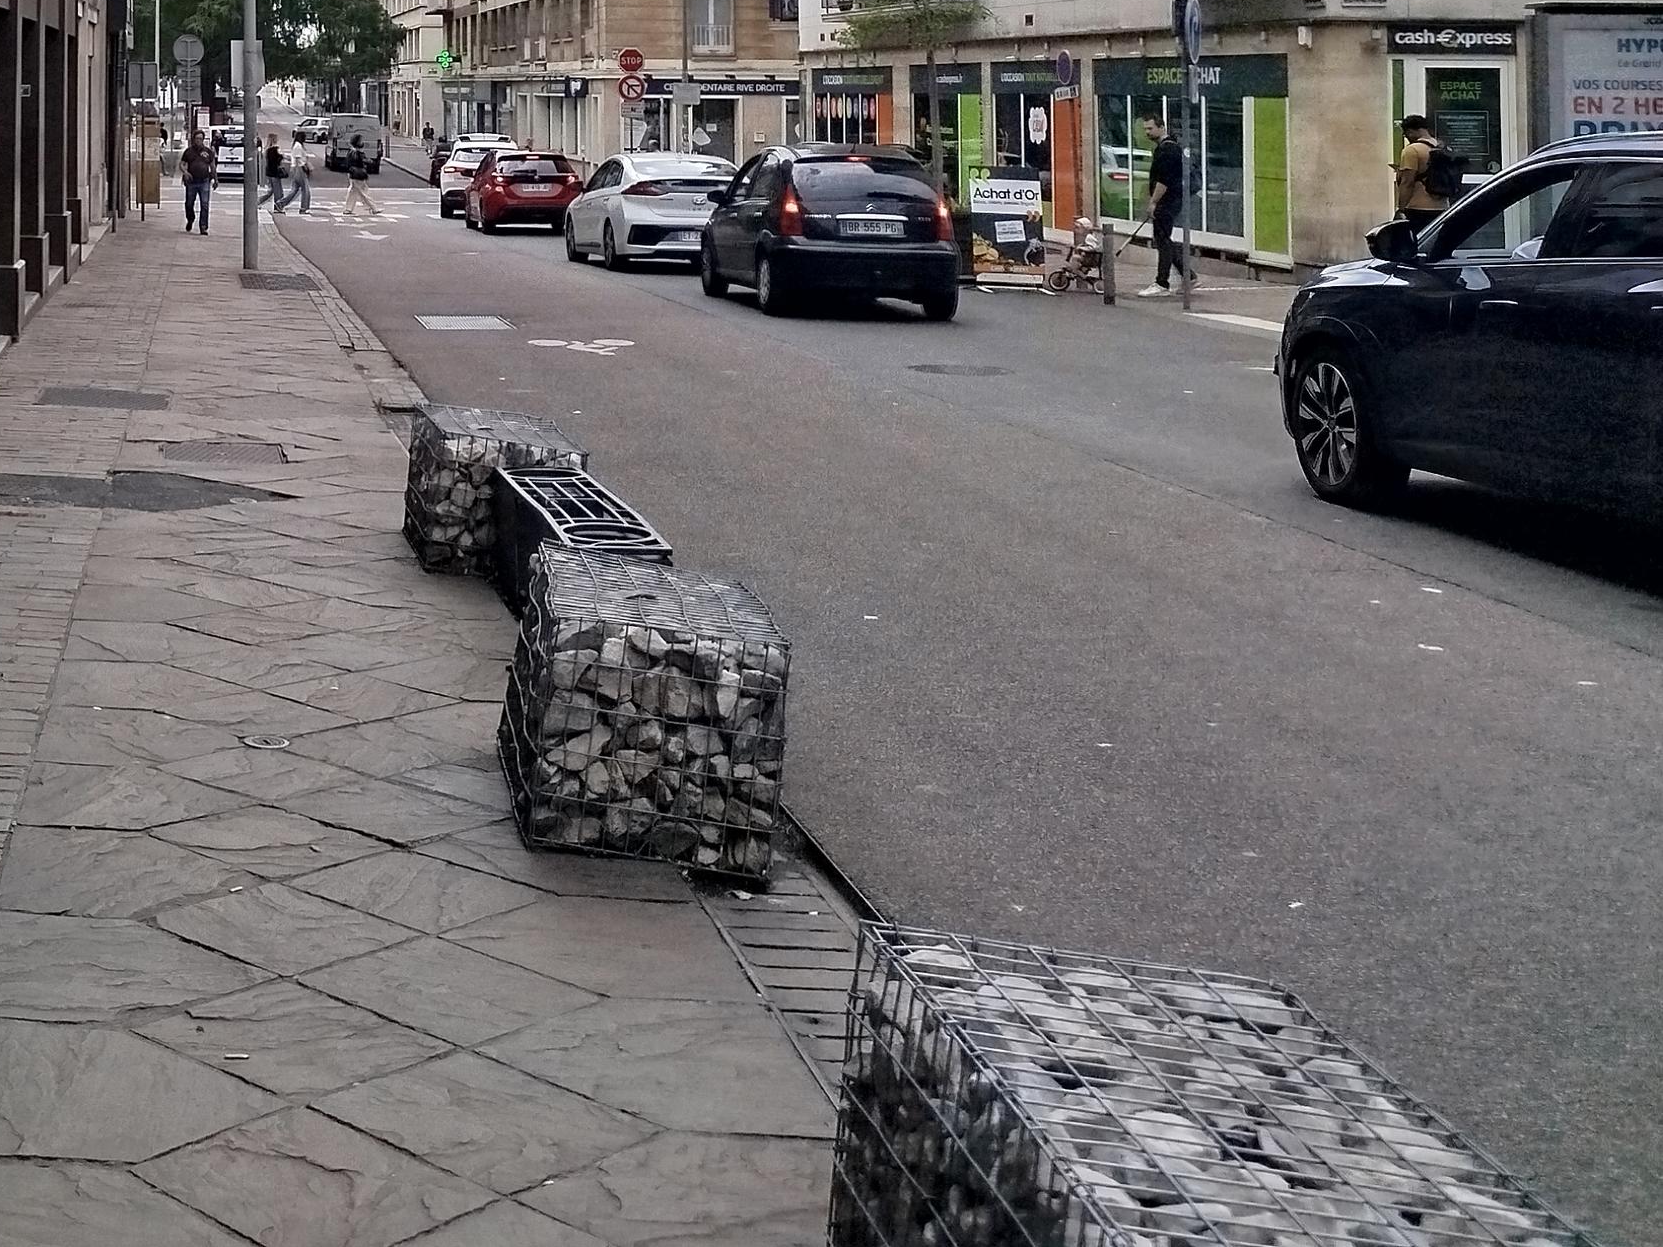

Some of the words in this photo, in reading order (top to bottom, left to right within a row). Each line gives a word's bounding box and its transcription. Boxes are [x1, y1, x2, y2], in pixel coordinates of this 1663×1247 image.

[621, 57, 642, 65] STOP
[1147, 67, 1183, 84] ESPACE
[1189, 65, 1221, 84] CHAT
[755, 84, 786, 92] DROITE
[1440, 81, 1482, 90] ESPACE
[1573, 79, 1599, 90] VOS
[1440, 91, 1482, 100] ACHAT
[1573, 96, 1603, 114] EN
[1612, 97, 1626, 114] 2
[973, 187, 1011, 200] Achat
[1013, 188, 1040, 201] d'Or
